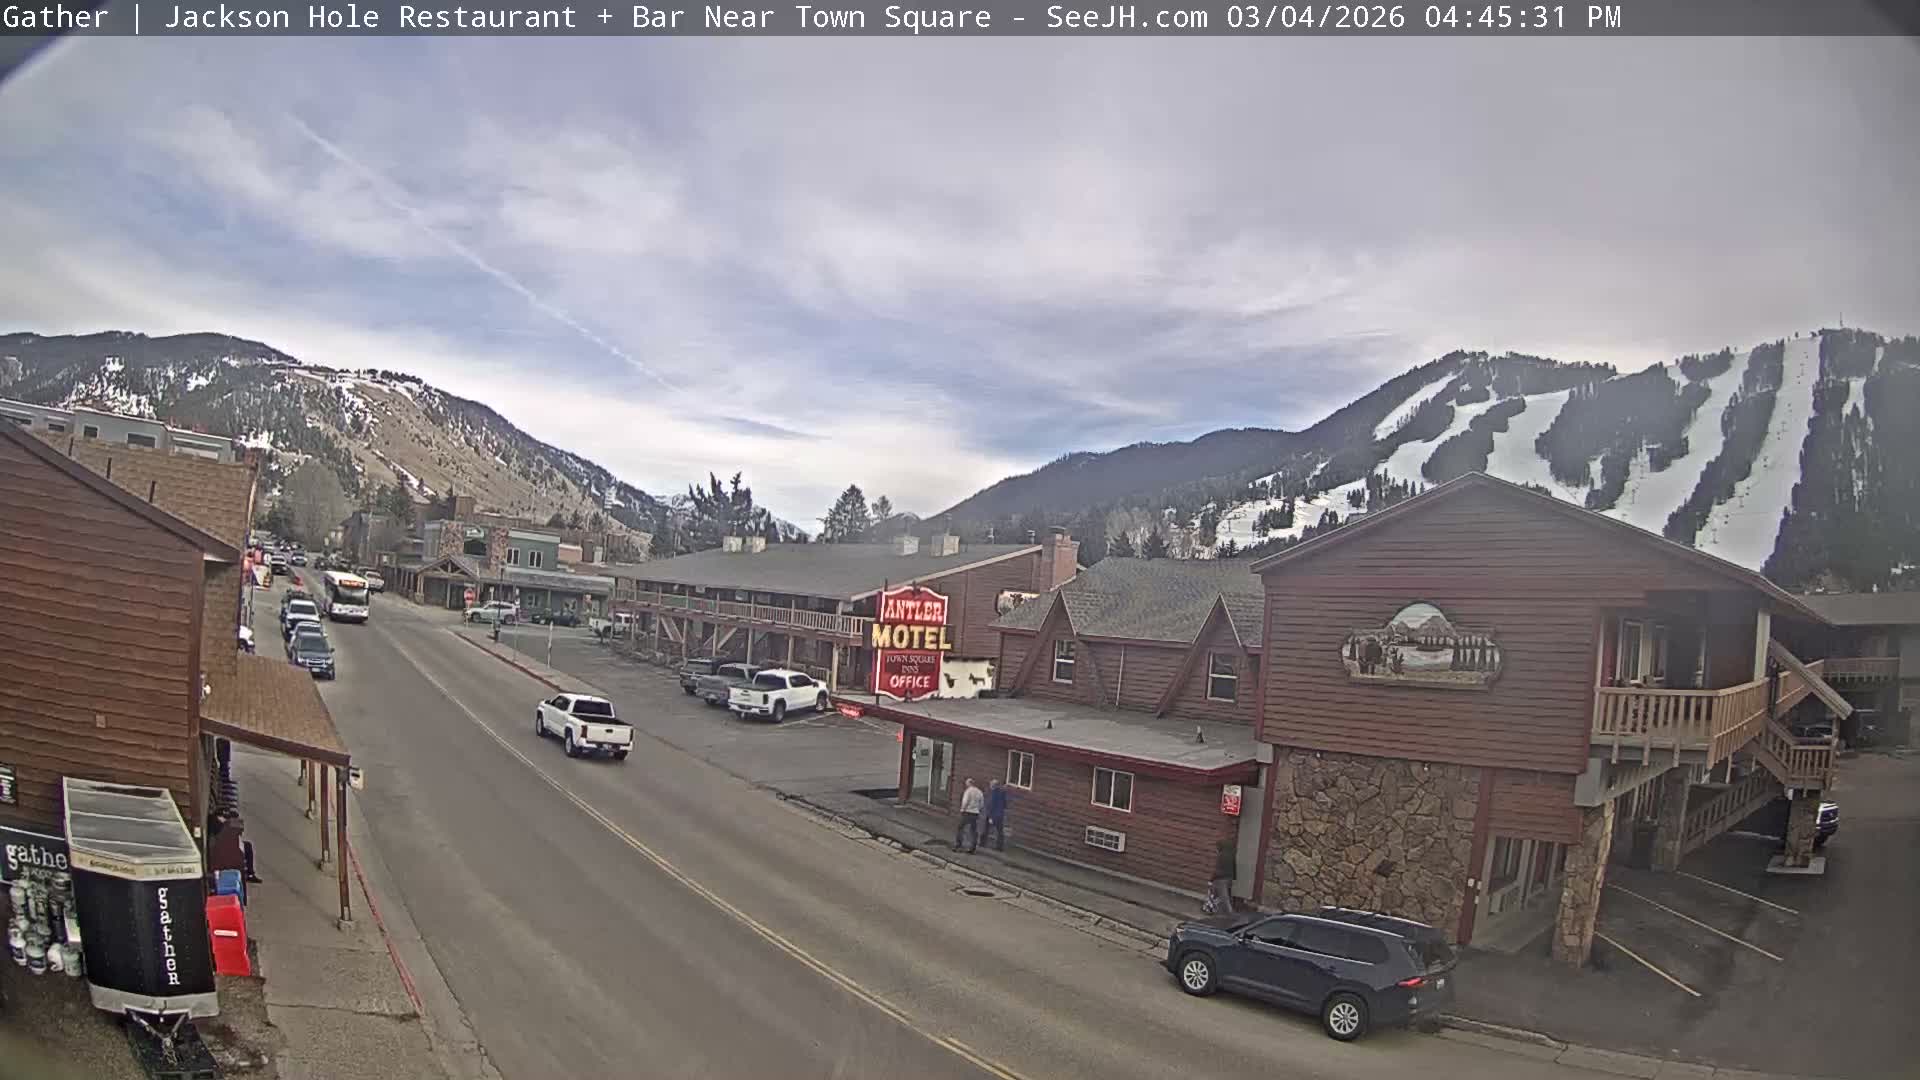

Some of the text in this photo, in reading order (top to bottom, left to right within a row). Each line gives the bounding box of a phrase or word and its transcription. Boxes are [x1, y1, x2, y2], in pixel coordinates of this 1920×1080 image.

[884, 599, 943, 622] ANTLER
[872, 623, 952, 650] MOTEL
[889, 674, 931, 689] OFFICE
[5, 844, 68, 871] gathe
